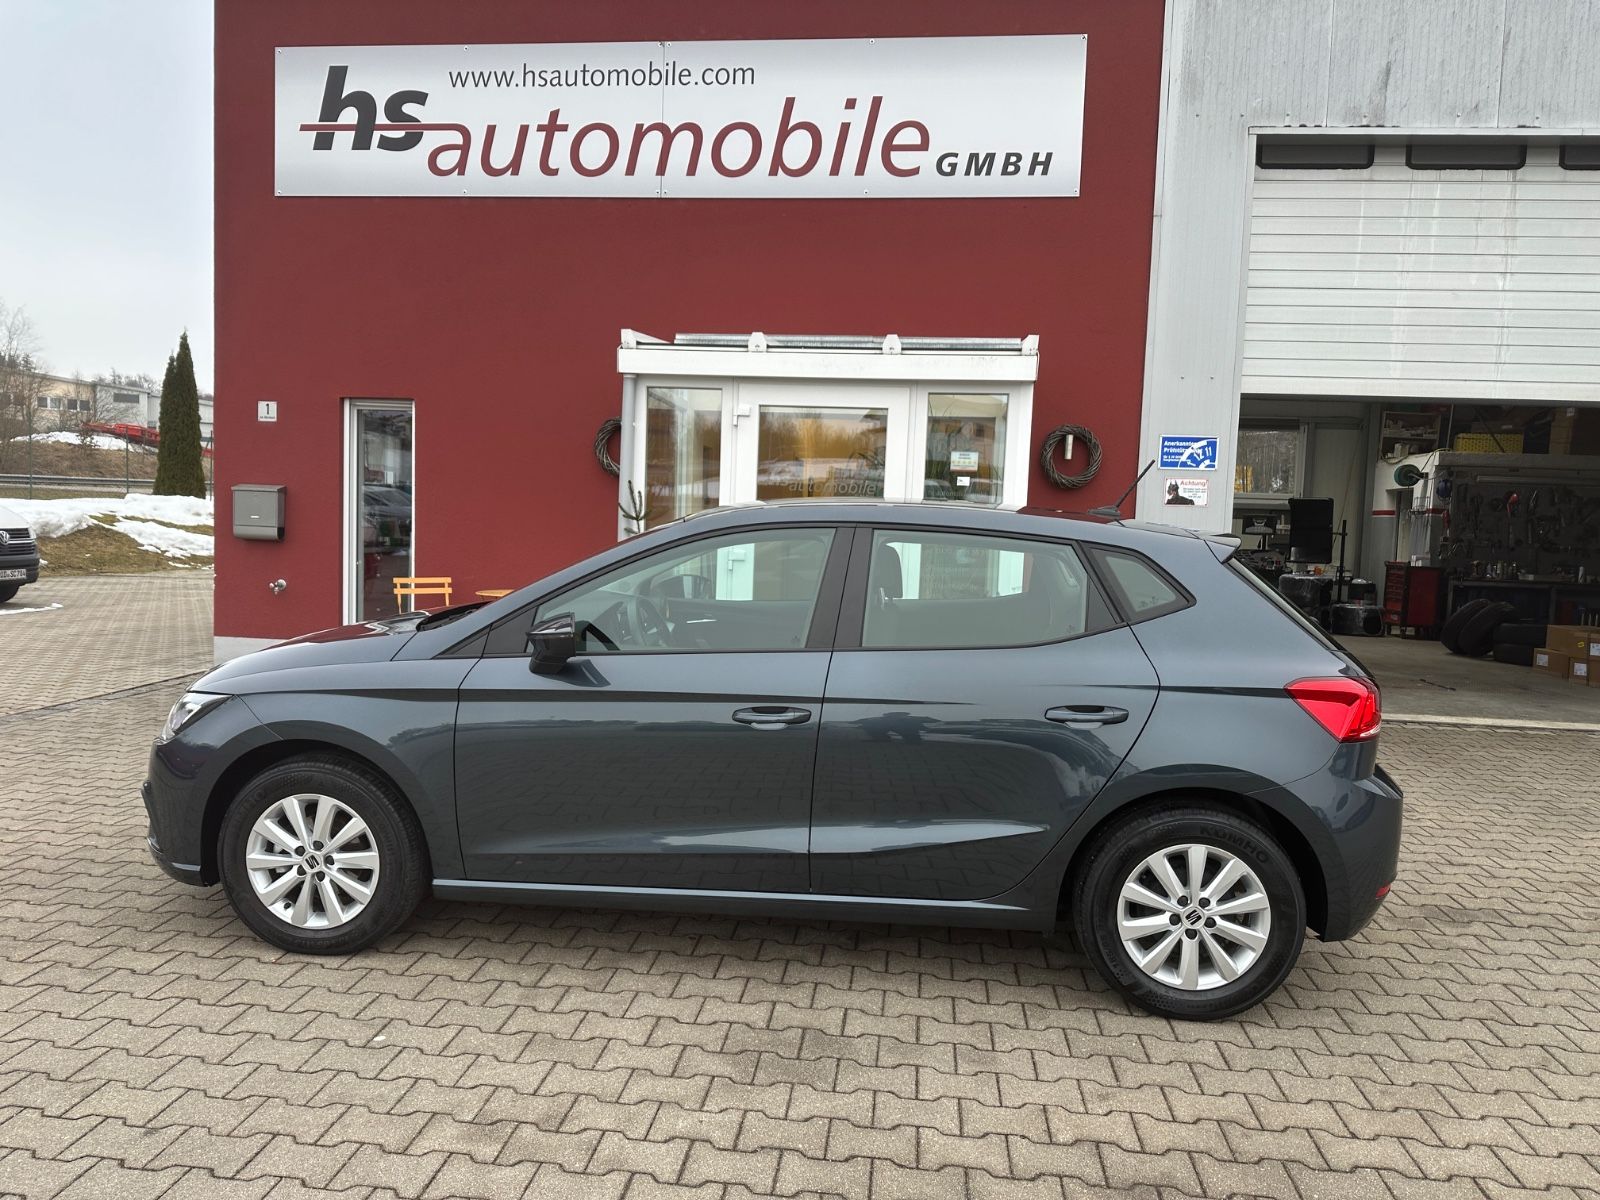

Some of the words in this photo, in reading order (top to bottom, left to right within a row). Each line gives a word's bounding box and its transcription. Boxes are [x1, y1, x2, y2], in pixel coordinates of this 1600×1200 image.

[449, 61, 755, 88] www.hsautomobile.com
[935, 151, 1054, 177] GMBH
[265, 403, 270, 415] 1
